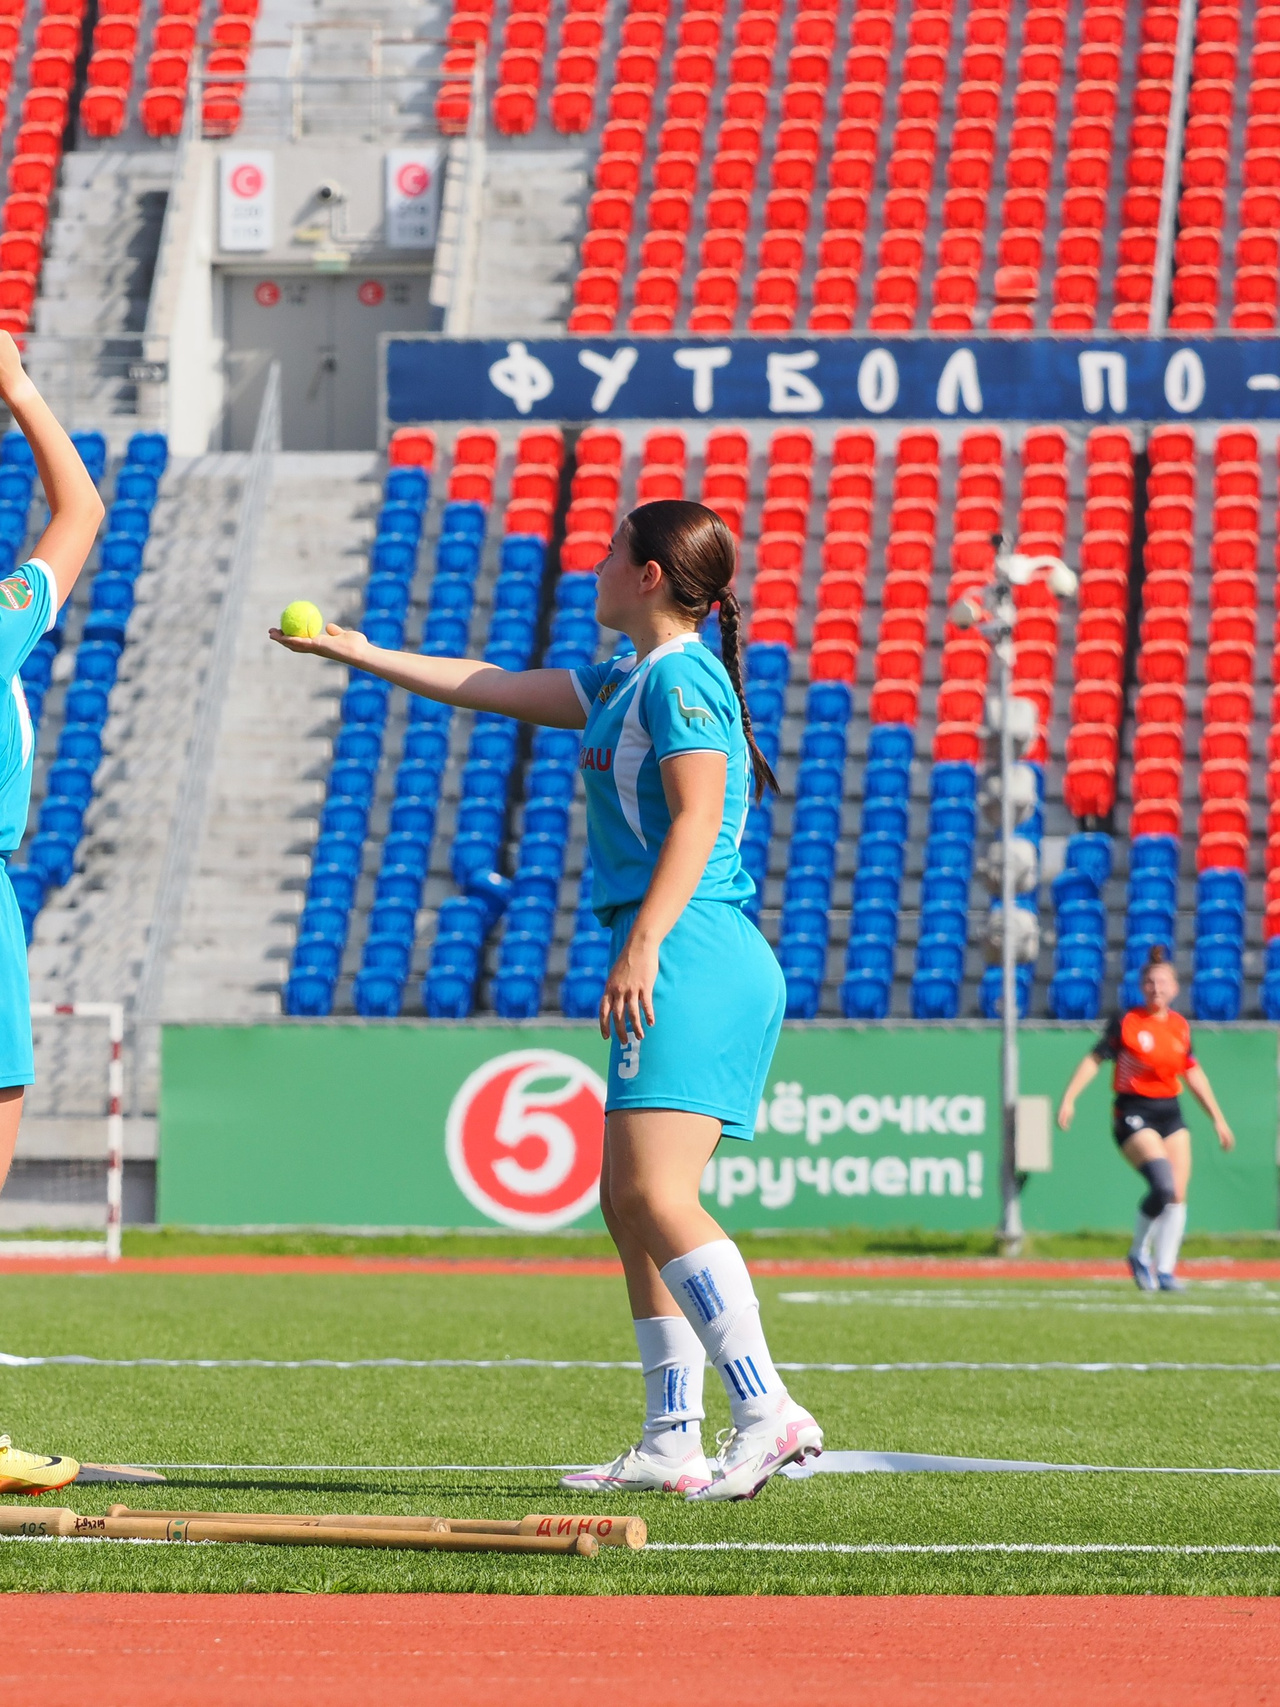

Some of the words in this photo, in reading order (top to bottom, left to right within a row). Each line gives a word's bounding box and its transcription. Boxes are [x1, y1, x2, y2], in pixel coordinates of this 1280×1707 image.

[488, 341, 984, 415] ФУТБОЛ
[617, 1032, 641, 1079] 3
[754, 1081, 986, 1144] ёрочка
[700, 1150, 984, 1209] ручает!
[20, 1522, 47, 1534] 105
[536, 1518, 613, 1537] ДИНО
